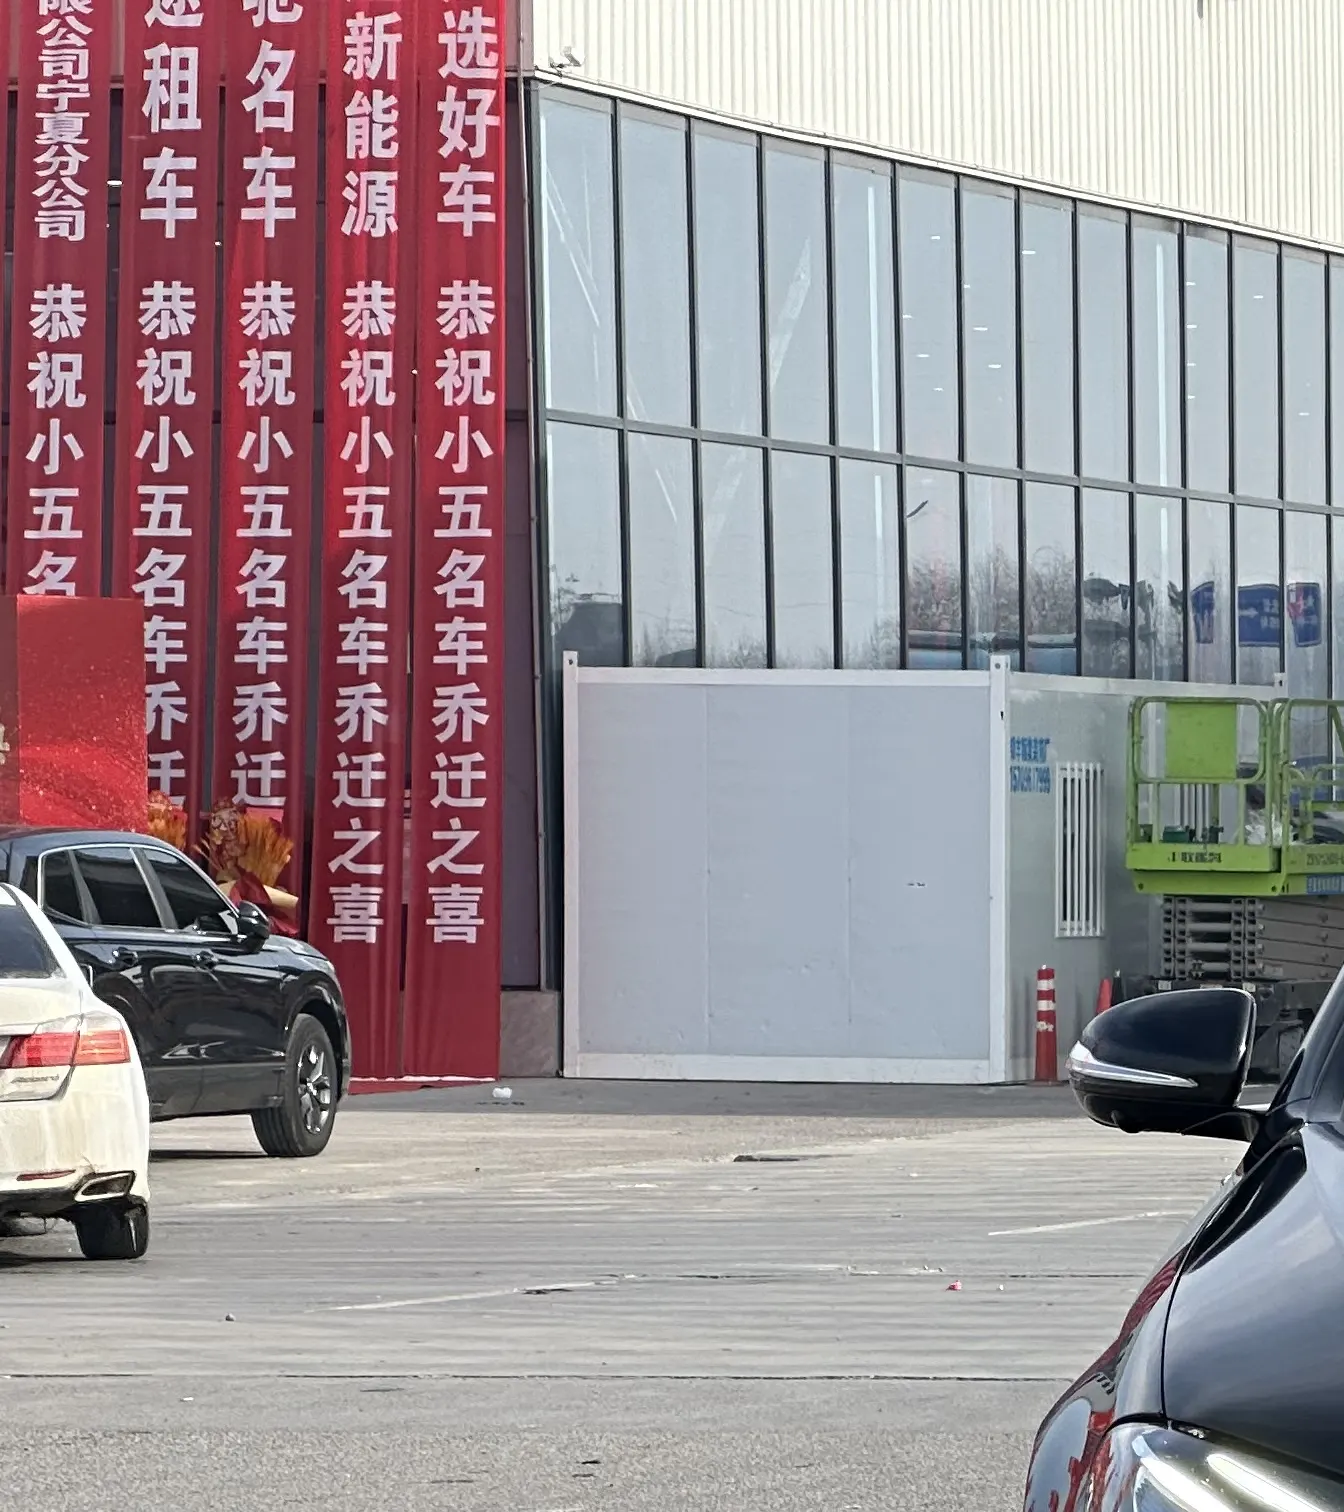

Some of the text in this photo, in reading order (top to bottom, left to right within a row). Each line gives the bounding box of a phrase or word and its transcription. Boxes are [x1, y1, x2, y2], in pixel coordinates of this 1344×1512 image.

[231, 0, 302, 805] 名车 恭祝小五名车乔迁
[327, 12, 402, 943] 新能源 恭祝小五名车乔迁之喜
[426, 10, 499, 943] 选好车 恭祝小五名车乔迁之喜
